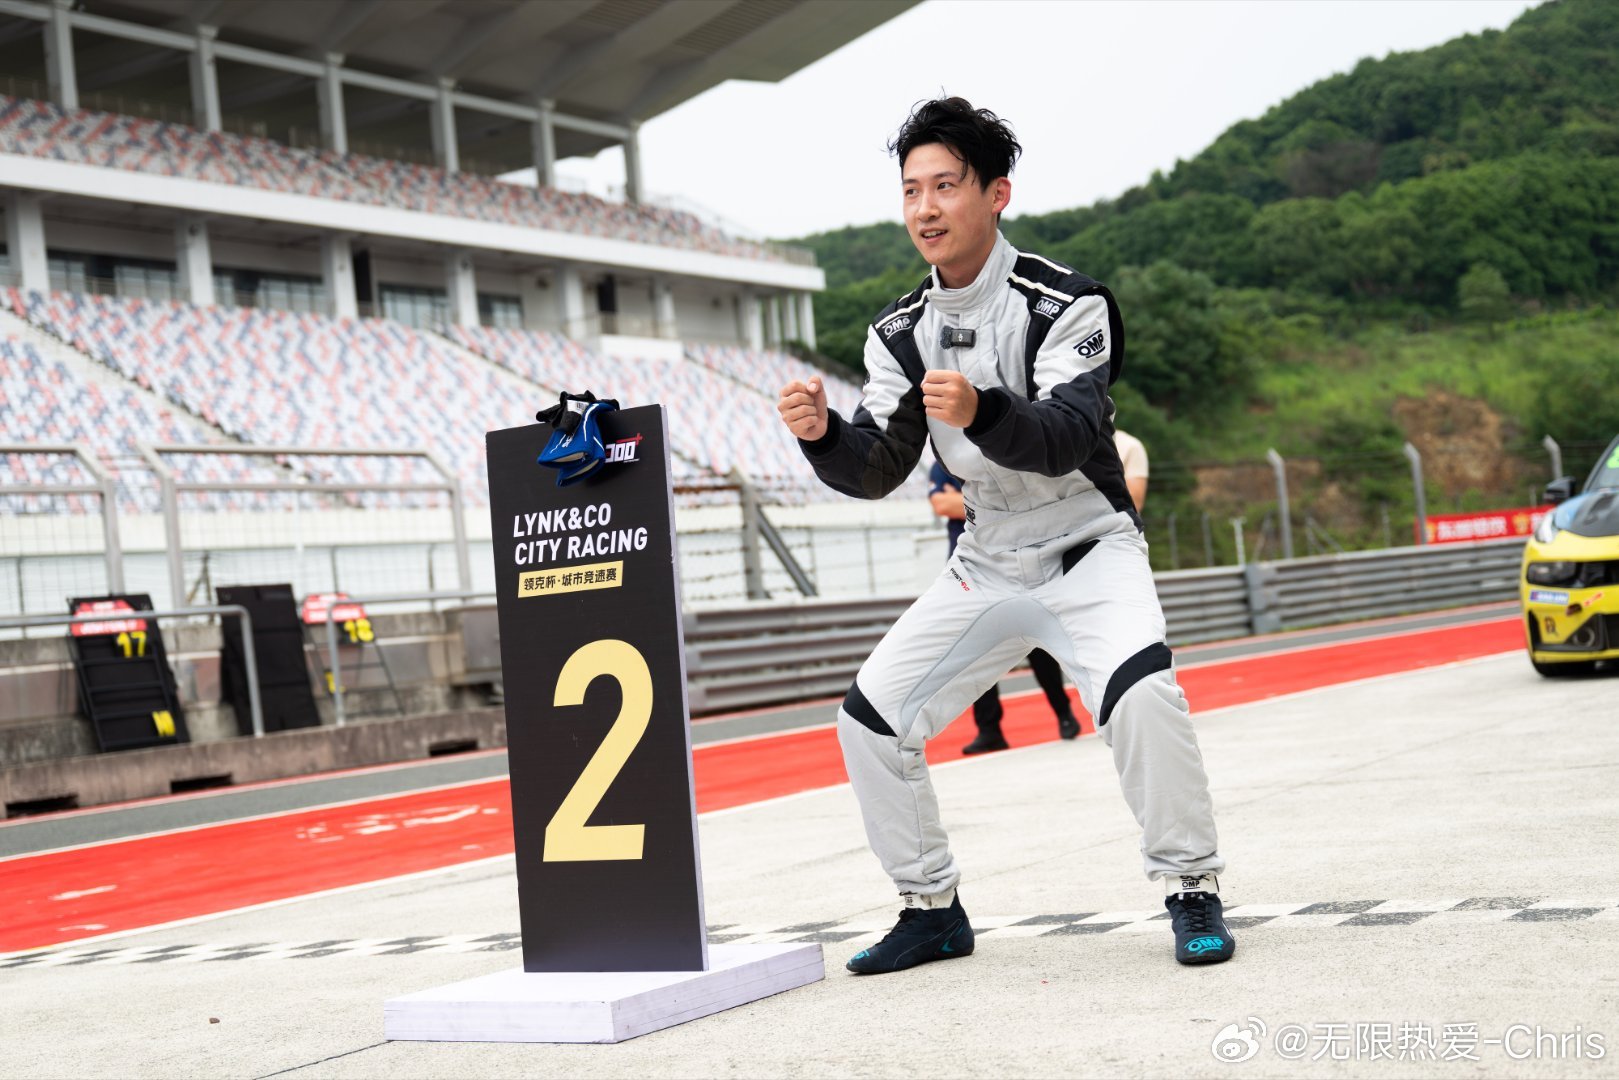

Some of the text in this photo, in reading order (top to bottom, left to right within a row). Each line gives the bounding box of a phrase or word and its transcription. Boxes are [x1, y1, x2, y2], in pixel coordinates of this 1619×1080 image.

[1035, 298, 1060, 316] OMP
[884, 317, 911, 336] OMP
[1077, 333, 1104, 356] OMP
[513, 502, 612, 538] LYNK&CO
[514, 526, 648, 566] CITY RACING
[117, 632, 146, 658] 17
[543, 639, 654, 862] 2
[1187, 938, 1224, 953] OMP
